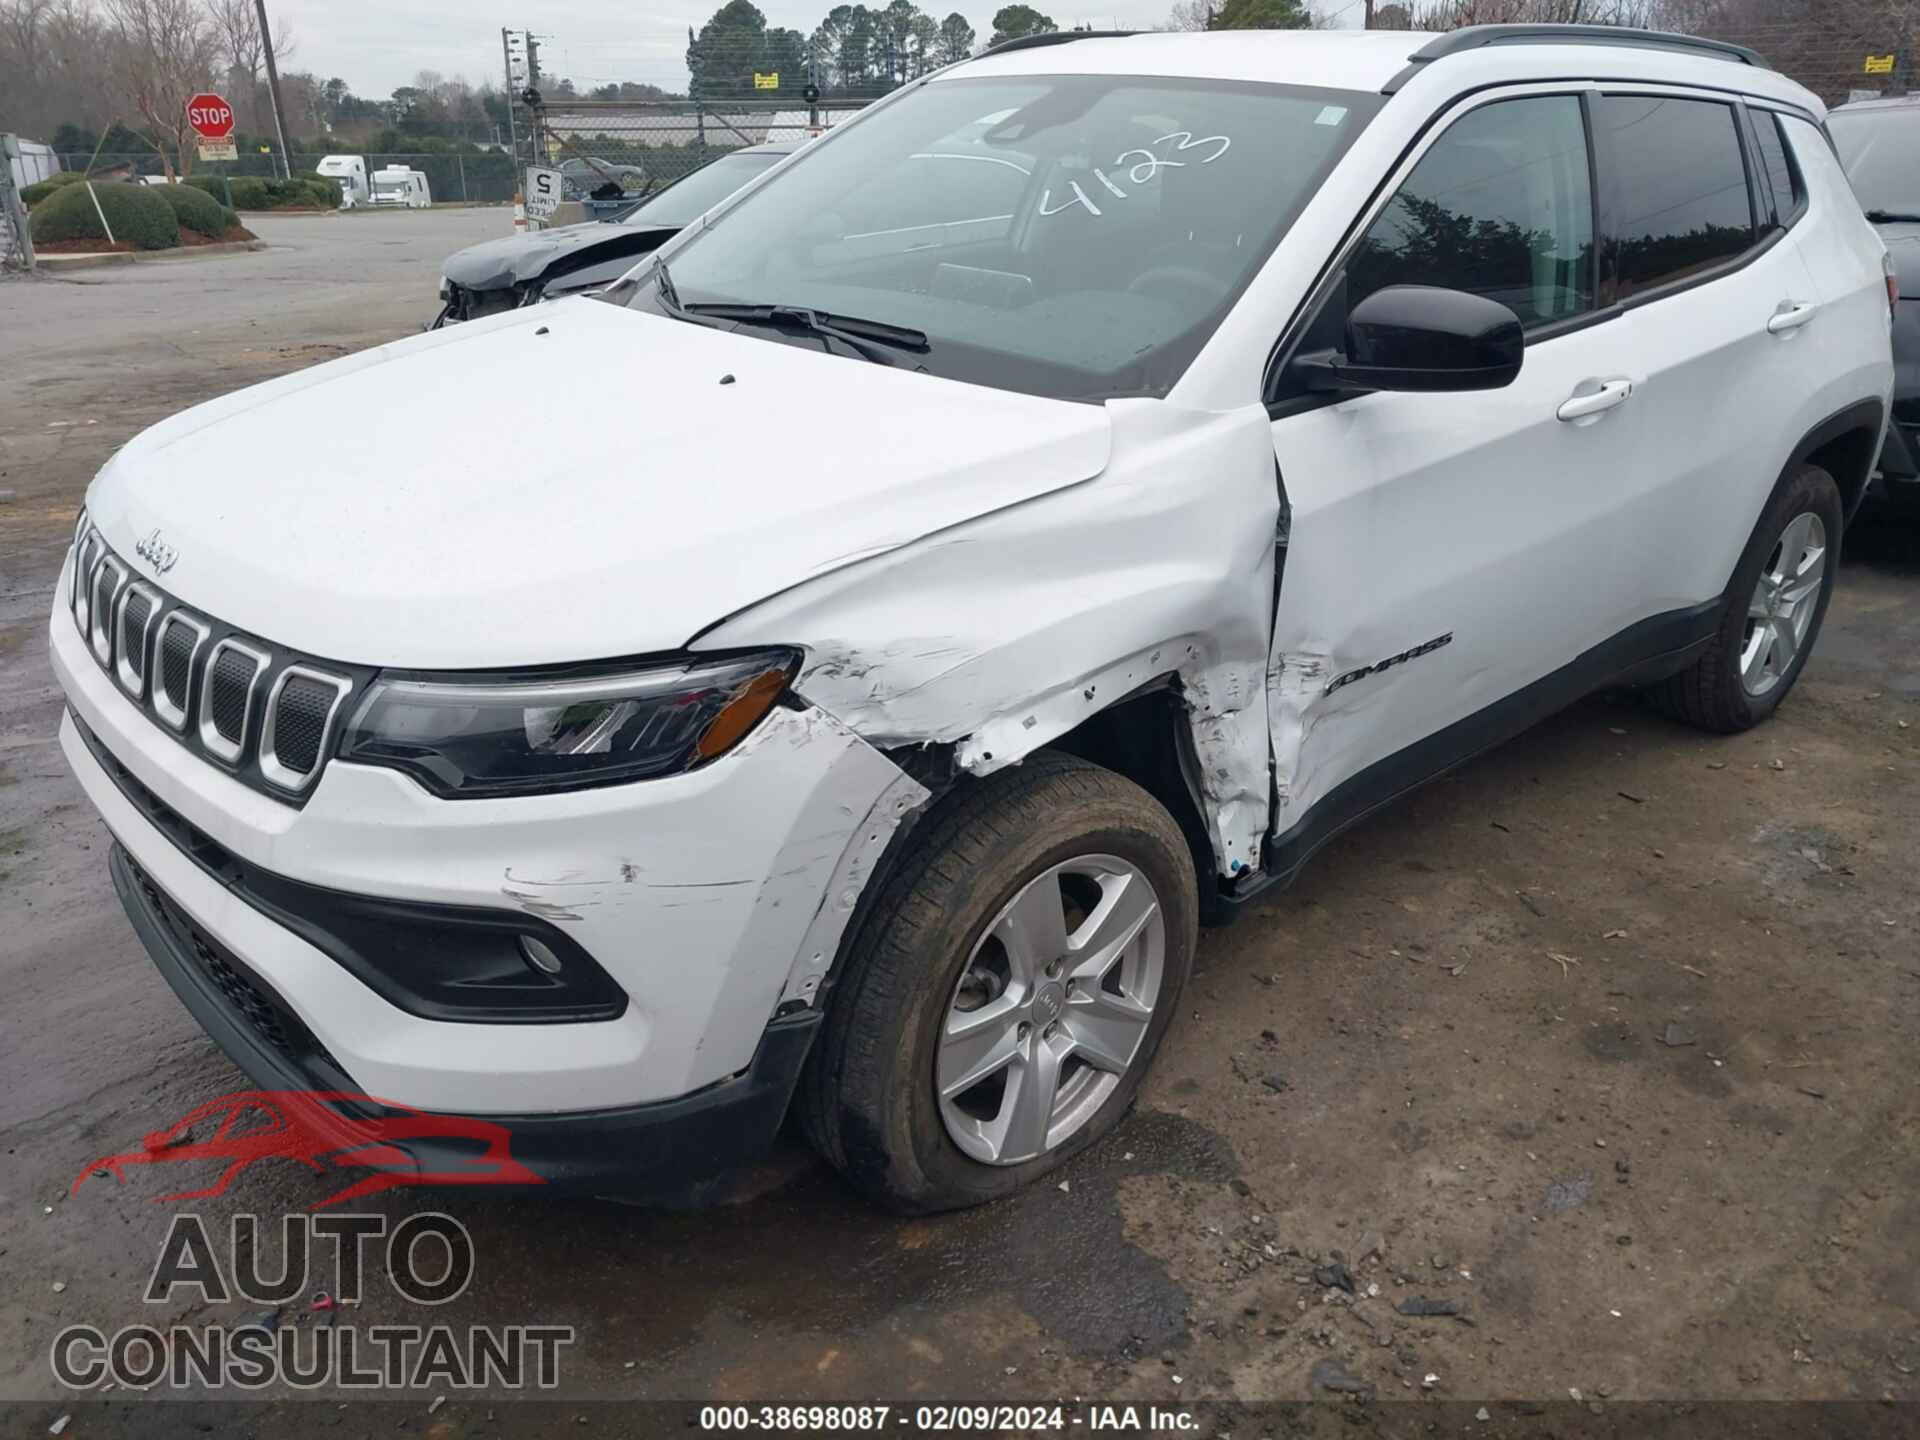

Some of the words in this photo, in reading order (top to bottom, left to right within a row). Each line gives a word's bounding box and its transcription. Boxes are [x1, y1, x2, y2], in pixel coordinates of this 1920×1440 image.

[191, 107, 230, 125] STOP
[536, 173, 552, 194] 5
[1039, 130, 1232, 217] 4123
[135, 527, 180, 577] Jeep
